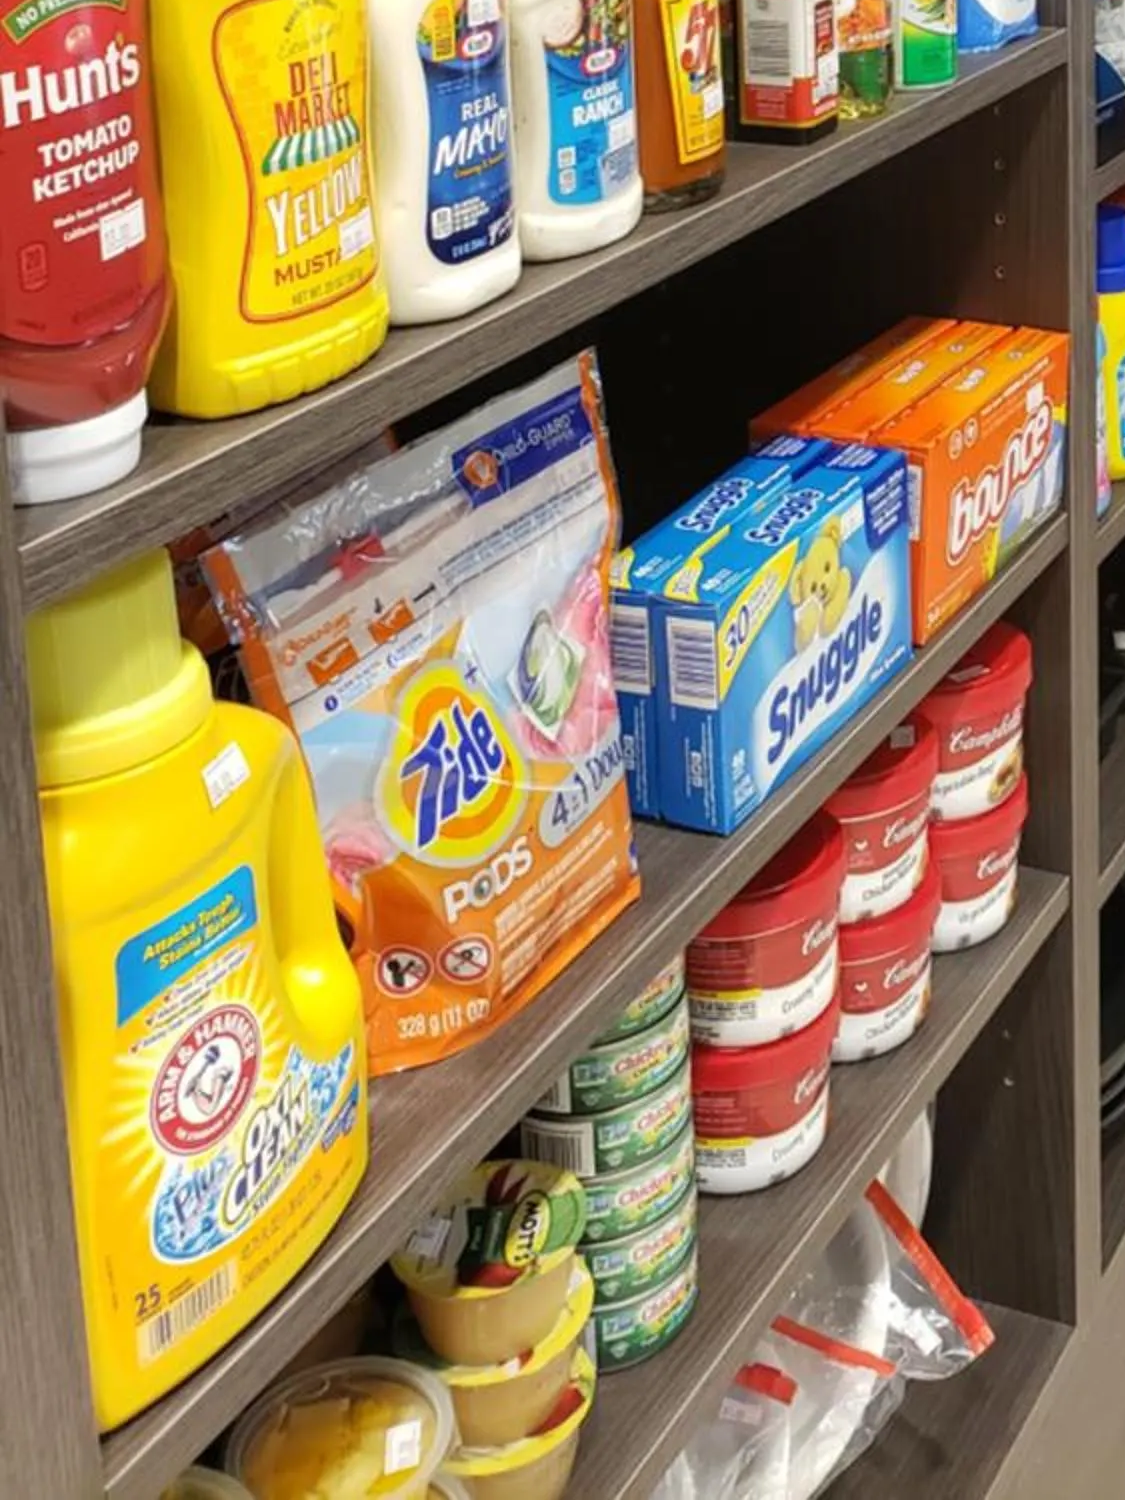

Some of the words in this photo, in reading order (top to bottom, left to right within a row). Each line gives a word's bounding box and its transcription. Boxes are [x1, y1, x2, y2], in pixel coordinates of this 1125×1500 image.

[16, 5, 37, 30] NO
[0, 33, 140, 129] Hunt's
[289, 51, 338, 98] DELI
[275, 82, 351, 137] MARKET
[461, 93, 498, 122] REAL
[572, 91, 624, 128] RANCH
[33, 140, 140, 203] KETCHUP
[38, 114, 132, 167] TOMATO
[434, 105, 509, 176] MAYO
[267, 153, 363, 258] YELLOW
[949, 399, 1051, 563] bounce
[725, 605, 750, 668] 30
[766, 592, 883, 765] Snuggle
[400, 696, 505, 850] Tide
[443, 836, 534, 924] PODS
[397, 1010, 425, 1040] 328
[157, 1066, 181, 1124] ARM
[176, 1042, 196, 1068] &
[192, 1012, 258, 1062] HAMMER
[135, 1283, 161, 1317] 25
